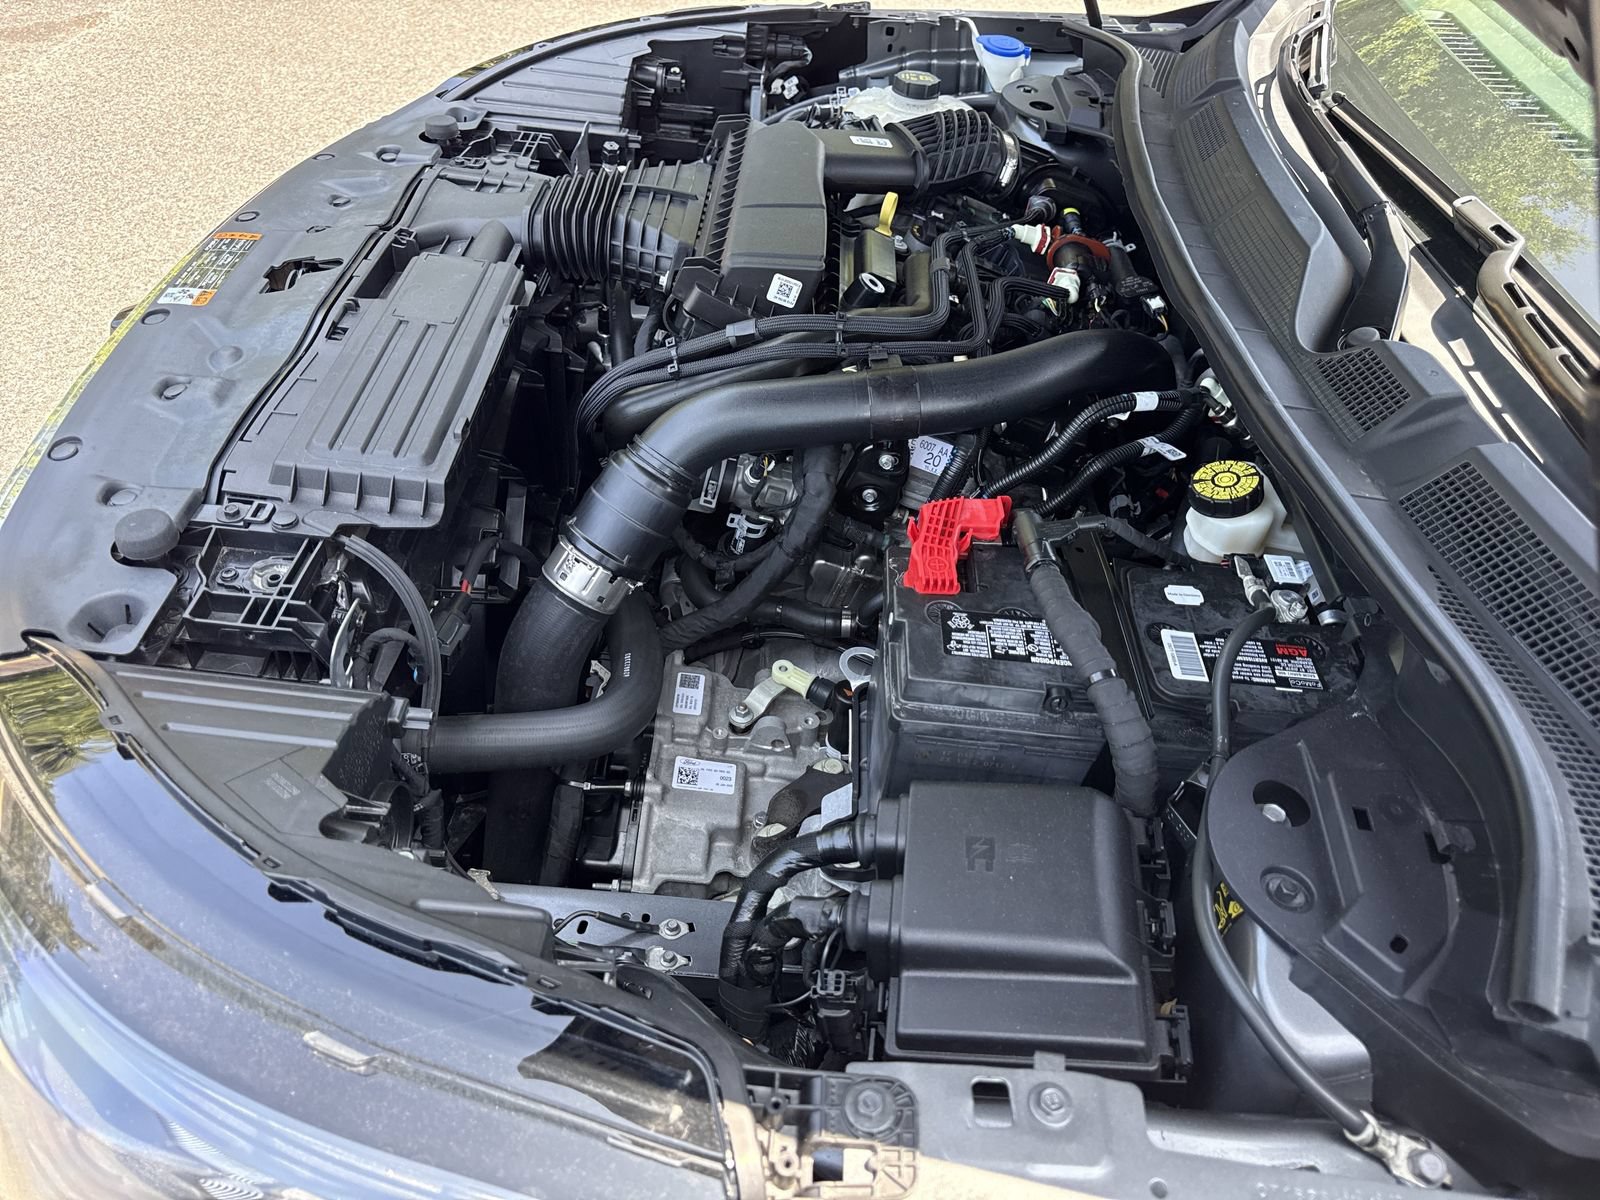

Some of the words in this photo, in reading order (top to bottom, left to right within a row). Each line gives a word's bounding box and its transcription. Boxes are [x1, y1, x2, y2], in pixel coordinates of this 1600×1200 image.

[920, 440, 936, 451] 6007
[938, 447, 949, 457] AA
[924, 452, 942, 467] 20
[1275, 647, 1308, 656] AGM
[1030, 656, 1073, 667] NGER/POISON
[1289, 679, 1321, 687] FoMoCo
